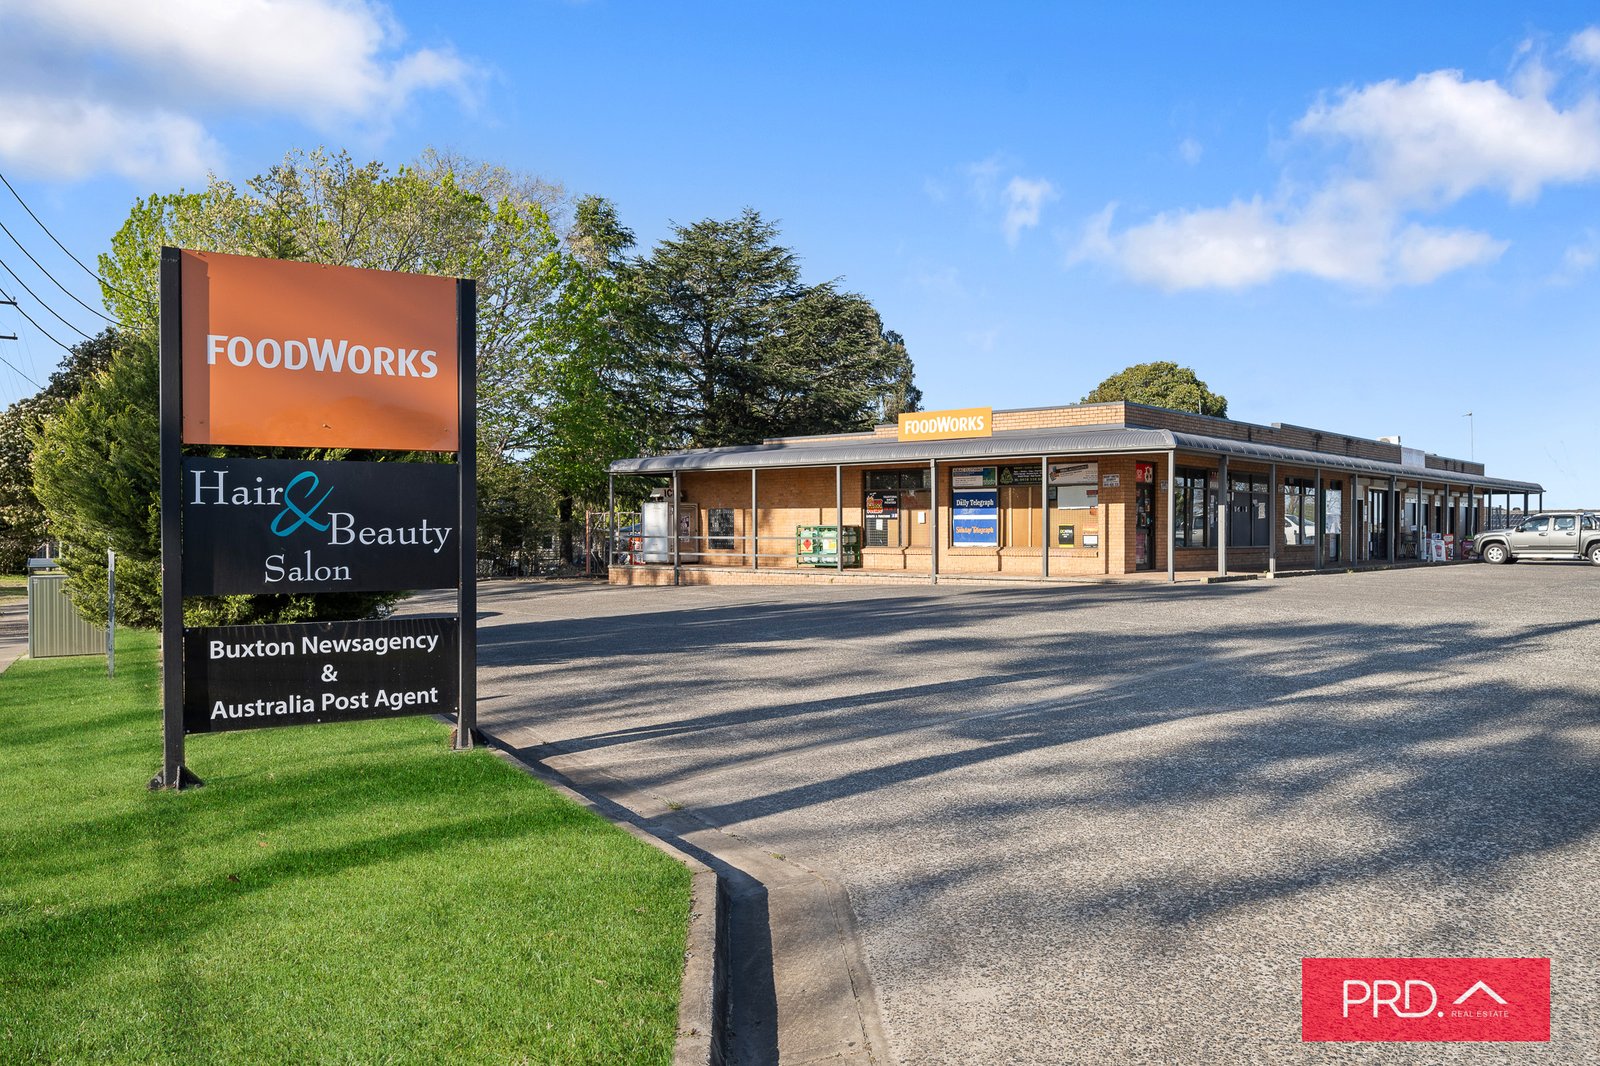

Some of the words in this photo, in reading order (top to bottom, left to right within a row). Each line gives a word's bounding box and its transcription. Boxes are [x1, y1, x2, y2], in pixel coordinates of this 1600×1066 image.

[207, 334, 438, 378] FOODWORKS
[905, 416, 984, 434] FOODWORKS
[190, 469, 283, 506] Hair
[270, 471, 334, 537] &
[327, 512, 452, 554] Beauty
[264, 550, 352, 584] Salon
[209, 638, 294, 659] Buxton
[302, 634, 439, 655] Newsagency
[320, 664, 338, 682] &
[210, 695, 315, 720] Australia
[322, 691, 368, 711] Post
[374, 687, 438, 711] Agent
